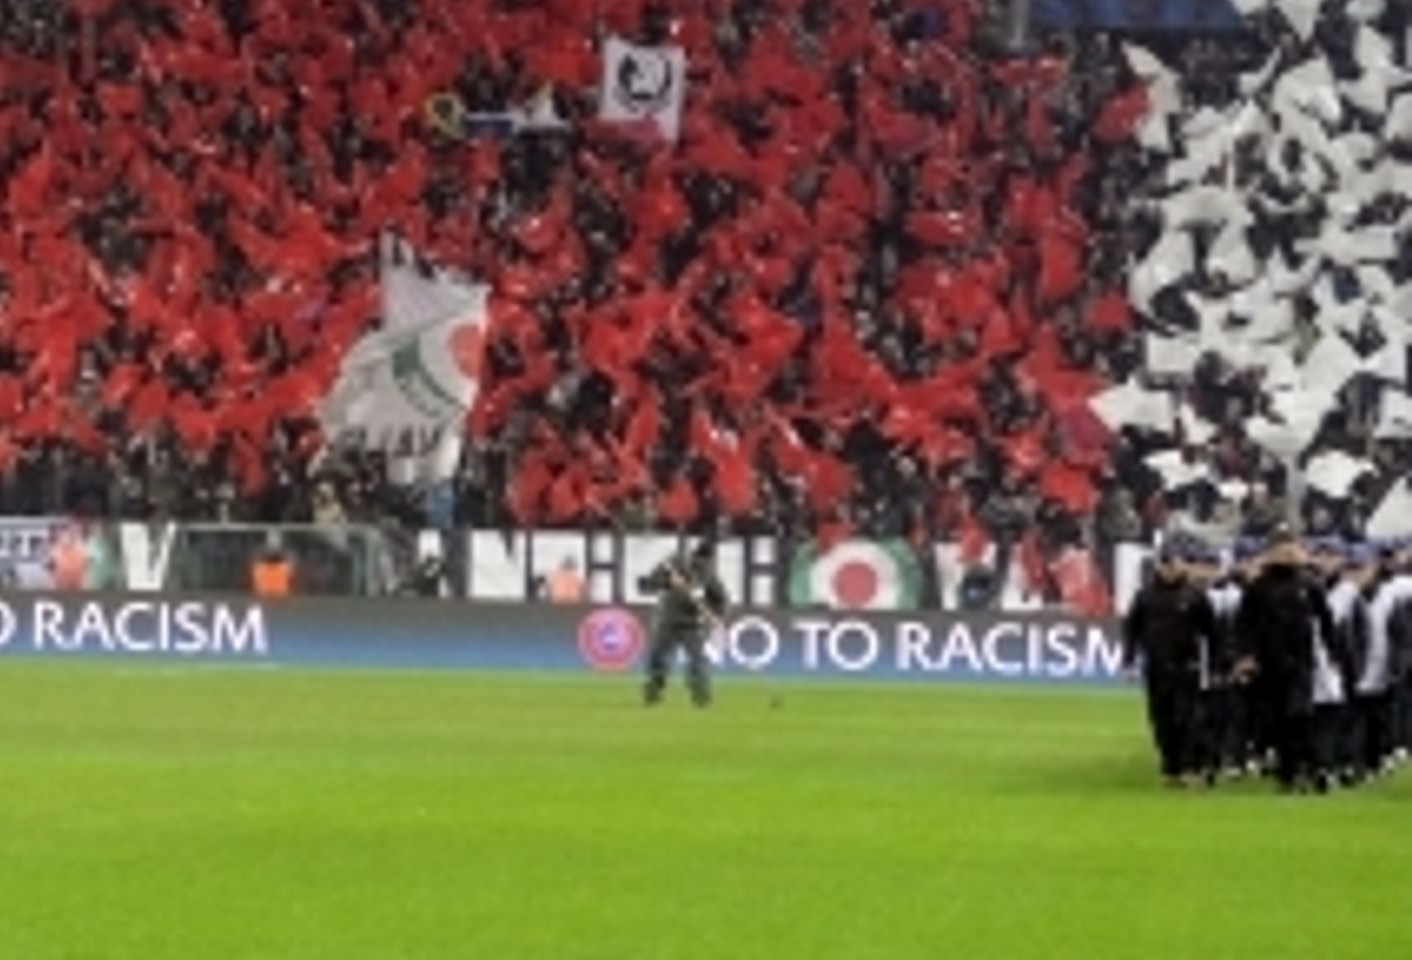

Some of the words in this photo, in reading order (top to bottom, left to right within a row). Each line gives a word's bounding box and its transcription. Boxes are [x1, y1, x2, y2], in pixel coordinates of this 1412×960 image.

[34, 600, 269, 654] RACISM
[791, 617, 880, 671] TO
[895, 620, 1124, 678] RACISM
